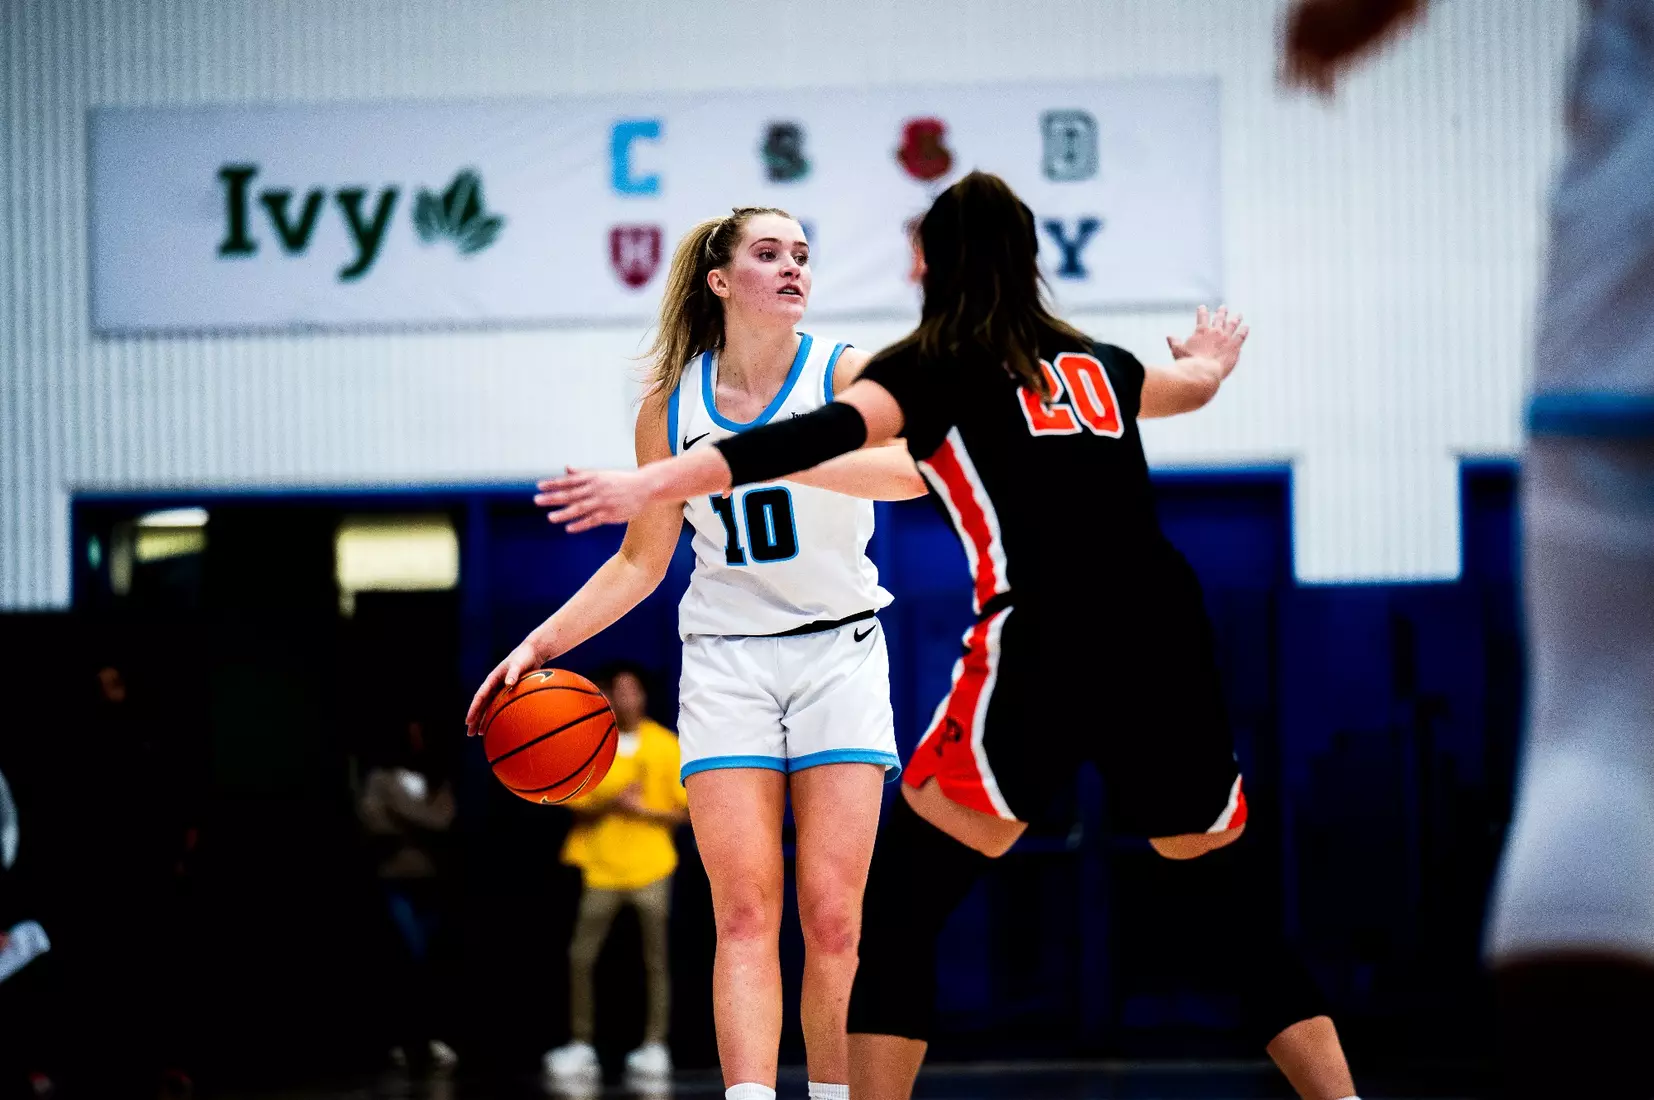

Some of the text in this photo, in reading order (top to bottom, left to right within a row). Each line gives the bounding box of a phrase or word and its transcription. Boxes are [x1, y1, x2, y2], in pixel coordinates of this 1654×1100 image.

[611, 118, 661, 195] C
[216, 163, 402, 282] Ivy
[1042, 217, 1103, 279] Y
[1016, 352, 1124, 438] 20
[709, 486, 799, 565] 10
